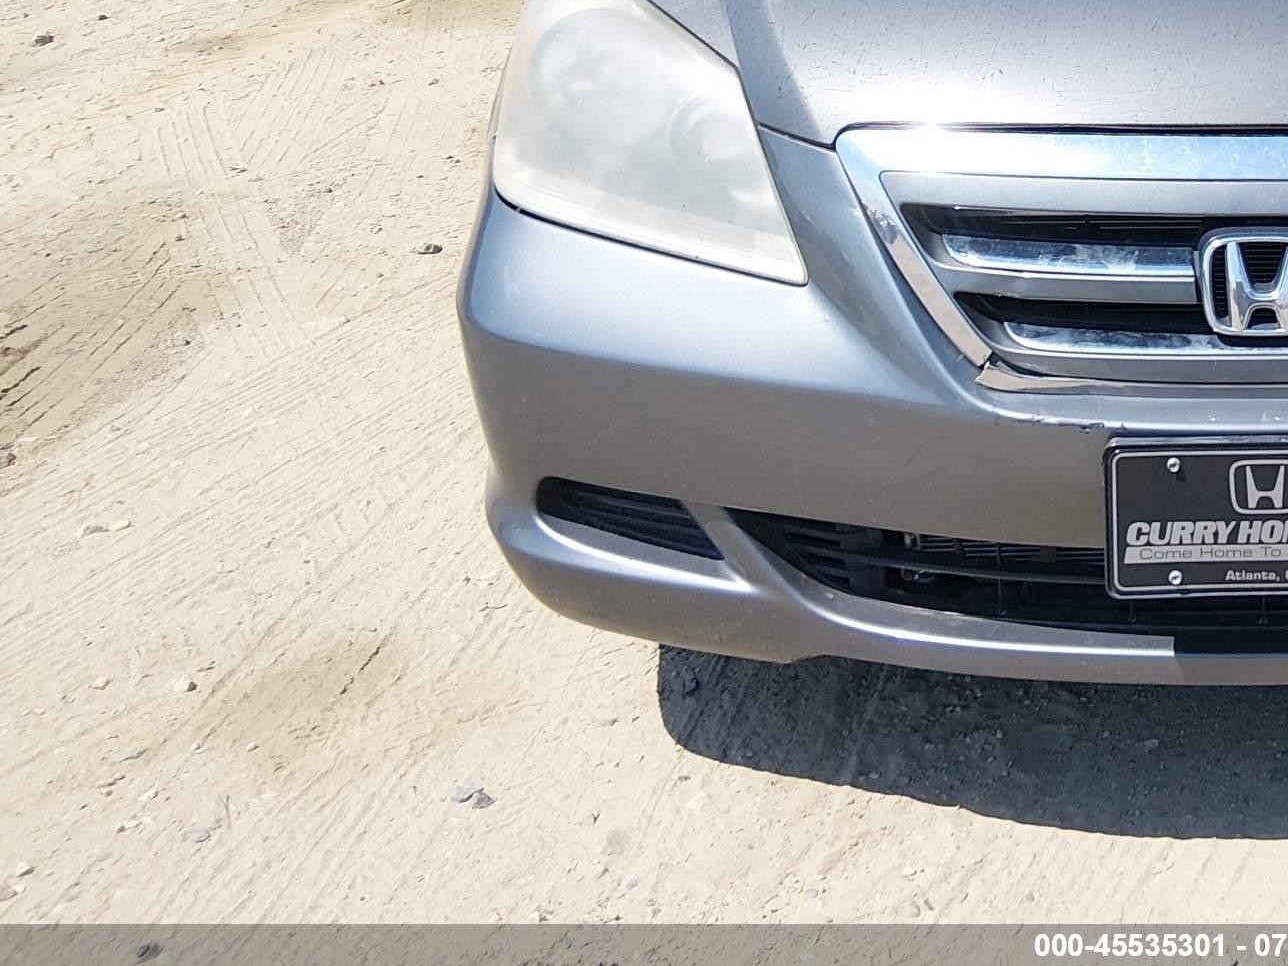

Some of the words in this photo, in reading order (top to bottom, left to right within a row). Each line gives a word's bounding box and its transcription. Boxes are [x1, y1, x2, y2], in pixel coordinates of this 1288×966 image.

[1126, 521, 1236, 546] CURRY
[1139, 547, 1193, 560] Come
[1200, 547, 1254, 559] Home
[1260, 546, 1281, 558] To
[1225, 569, 1280, 582] Atlanta,
